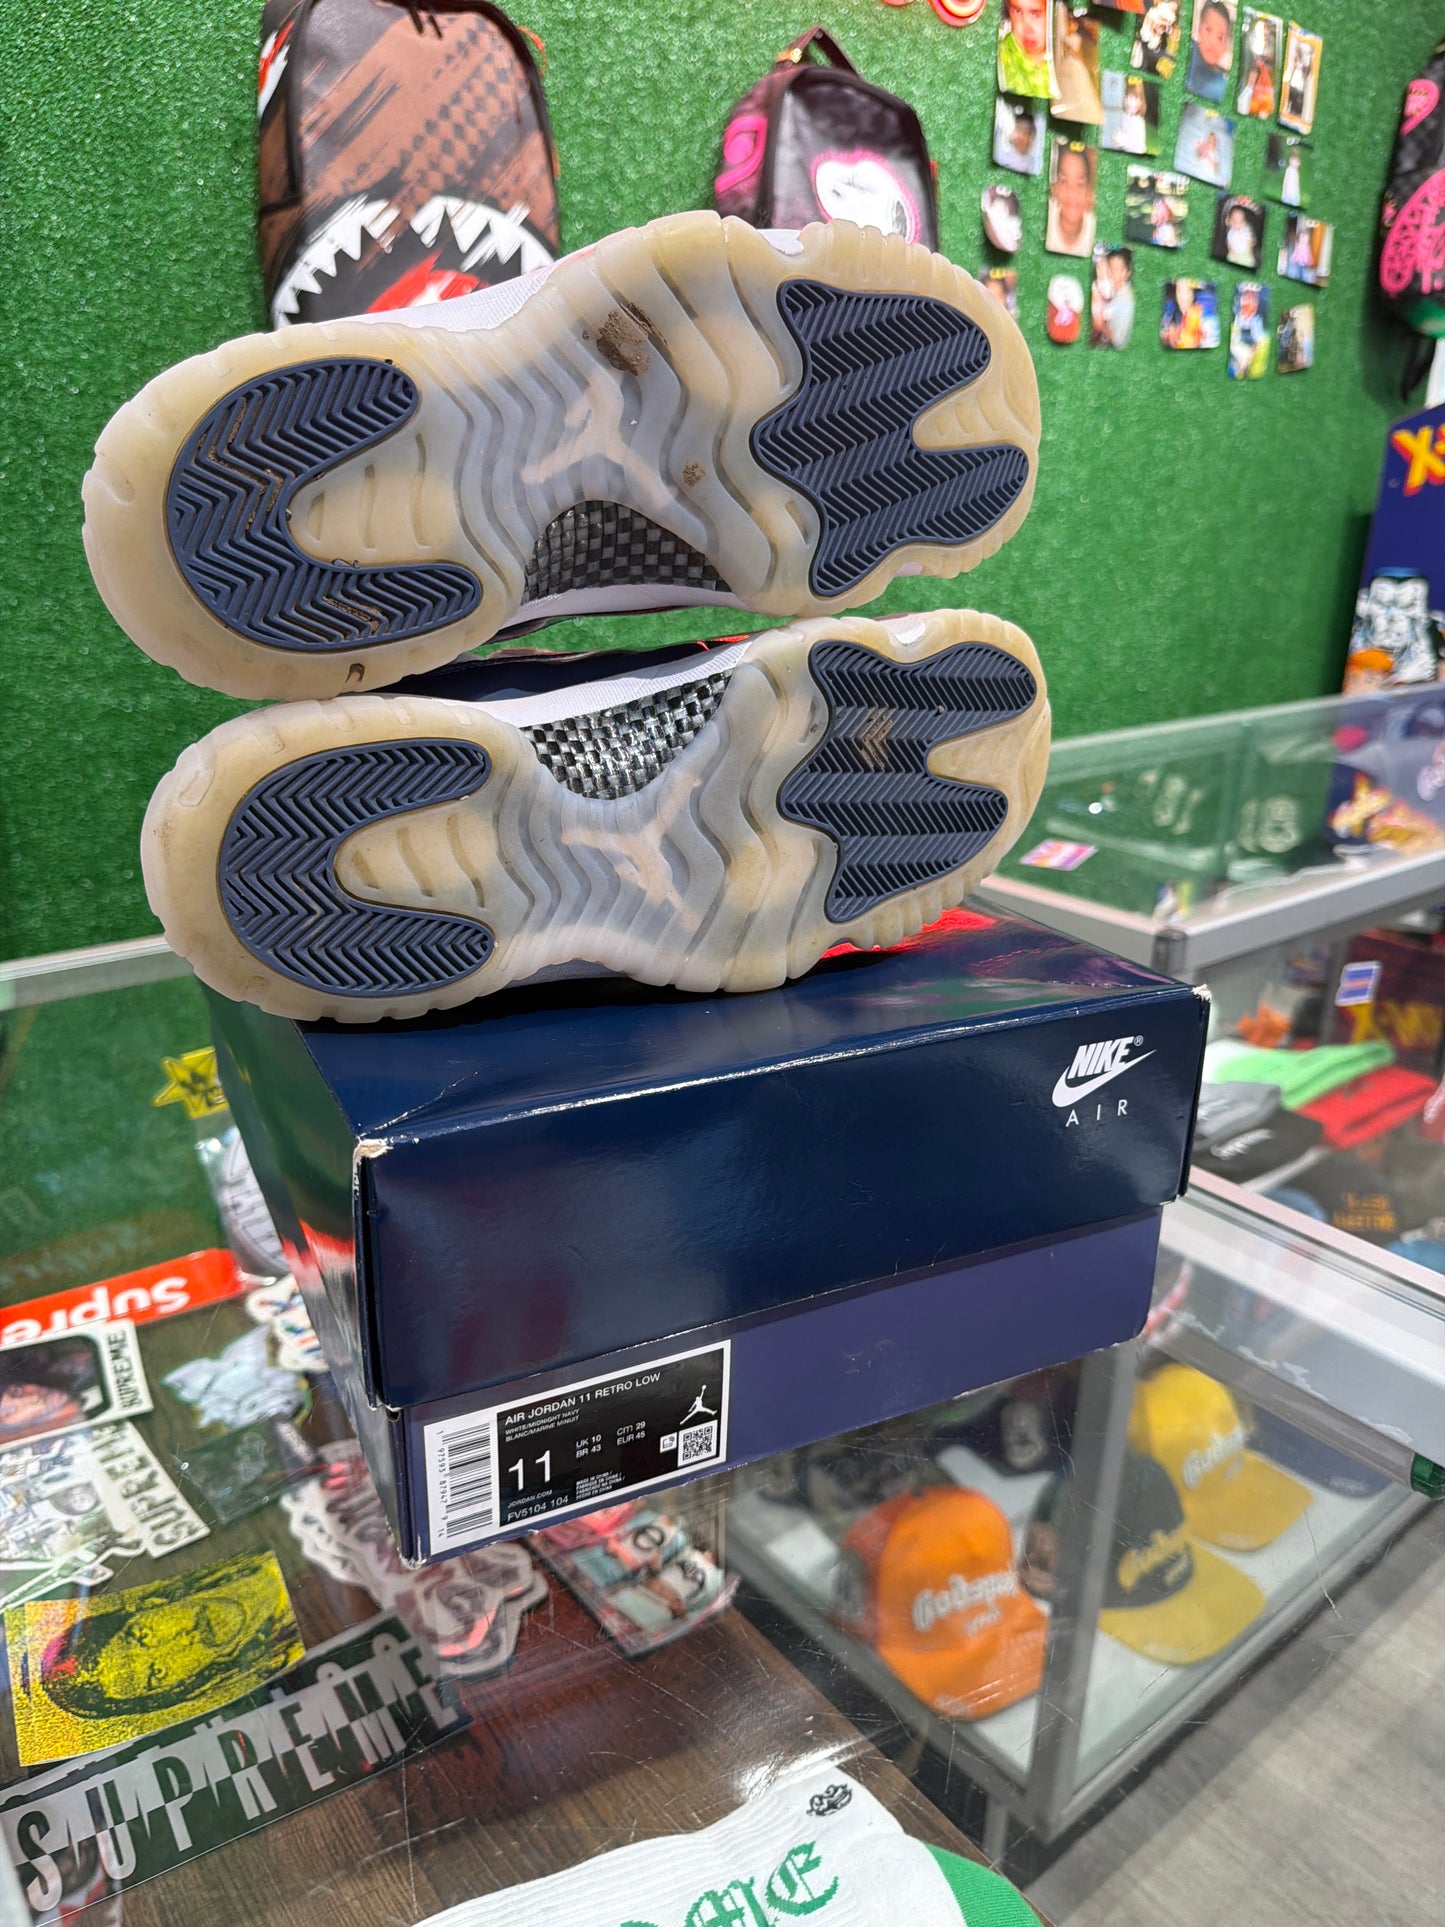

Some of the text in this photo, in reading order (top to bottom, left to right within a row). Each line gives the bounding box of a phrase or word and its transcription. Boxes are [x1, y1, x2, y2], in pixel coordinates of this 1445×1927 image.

[1067, 1036, 1134, 1079] NIKE
[1065, 1099, 1128, 1128] AIR
[504, 1372, 661, 1426] AIR JORDAN 11 RETRO LOW
[505, 1408, 580, 1435] WHITE/MIDNIGHT NAVY
[505, 1415, 579, 1443] BLANC/MARINE MINUIT
[635, 1421, 646, 1431] 29
[576, 1434, 602, 1448] UK 10
[576, 1444, 602, 1459] BR 43
[616, 1431, 646, 1446] EUR 45
[508, 1449, 551, 1492] 11
[507, 1489, 553, 1509] JORDAN.COM
[507, 1495, 569, 1522] FV5104 104
[16, 1646, 459, 1912] SUPREME
